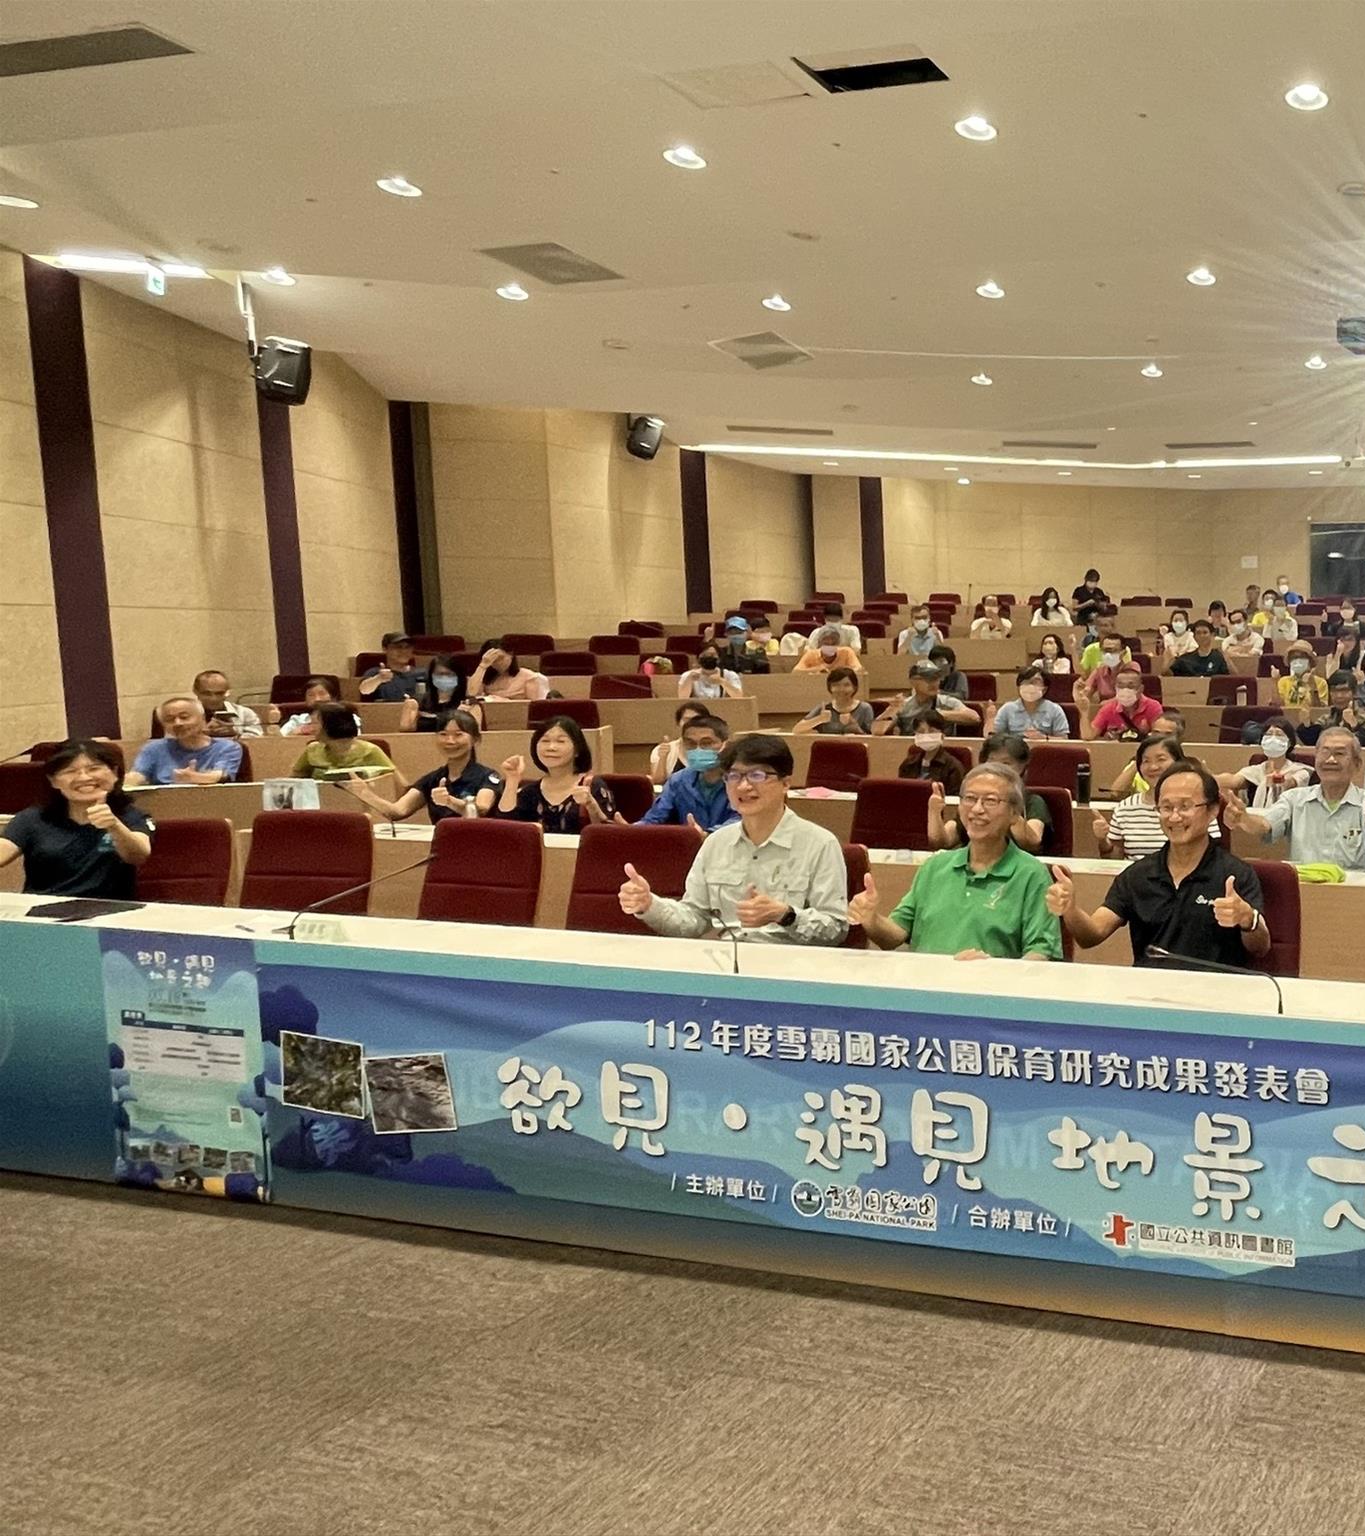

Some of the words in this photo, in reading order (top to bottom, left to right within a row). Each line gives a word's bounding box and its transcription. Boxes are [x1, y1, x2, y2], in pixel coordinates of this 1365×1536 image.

[644, 1018, 1331, 1105] 112年度雪霸國家公園保育研究成果發表會
[686, 1173, 767, 1202] 主辦單位
[863, 1212, 907, 1226] NATIONAL
[910, 1218, 935, 1229] PARK
[967, 1205, 1058, 1236] 合辦單位
